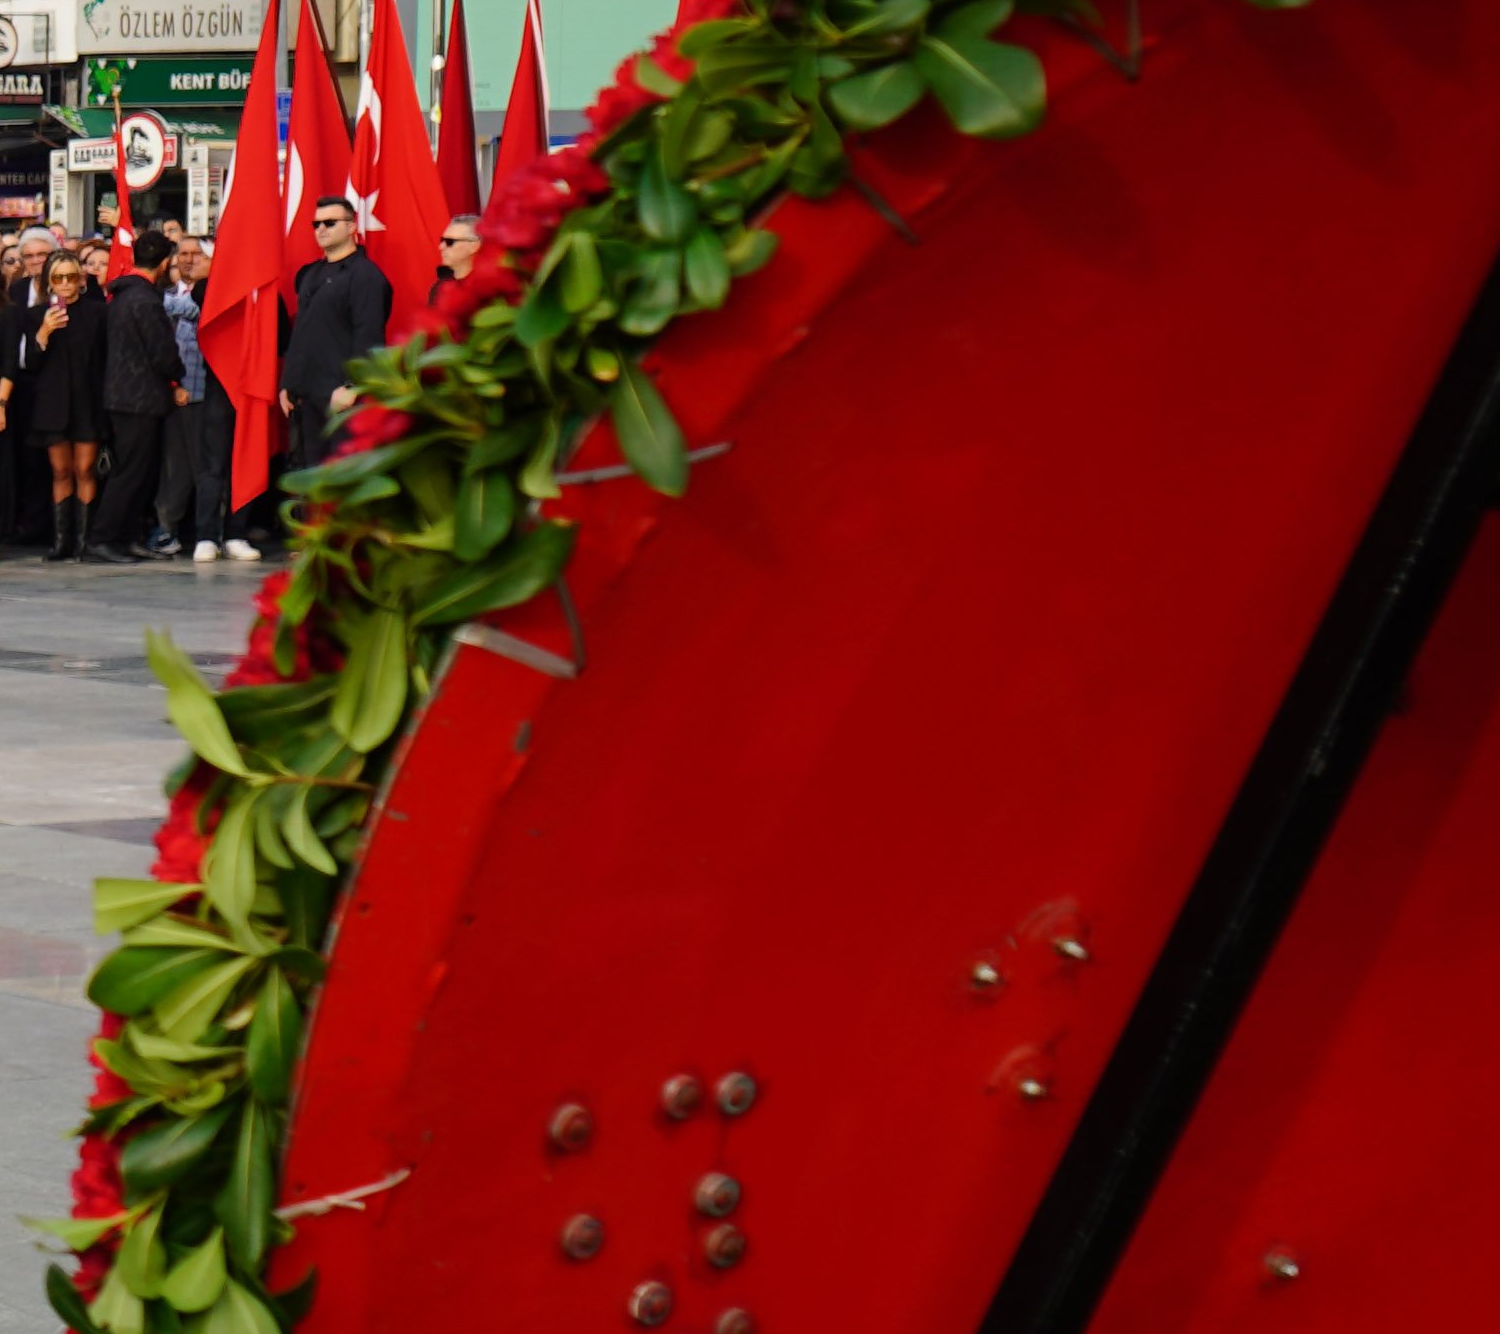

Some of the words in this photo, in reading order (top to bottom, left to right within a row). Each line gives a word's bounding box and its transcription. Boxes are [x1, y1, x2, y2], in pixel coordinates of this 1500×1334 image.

[120, 5, 175, 38] ÖZLEM
[182, 3, 243, 38] ÖZGÜN
[170, 72, 215, 90] KENT
[218, 67, 251, 90] BÜF
